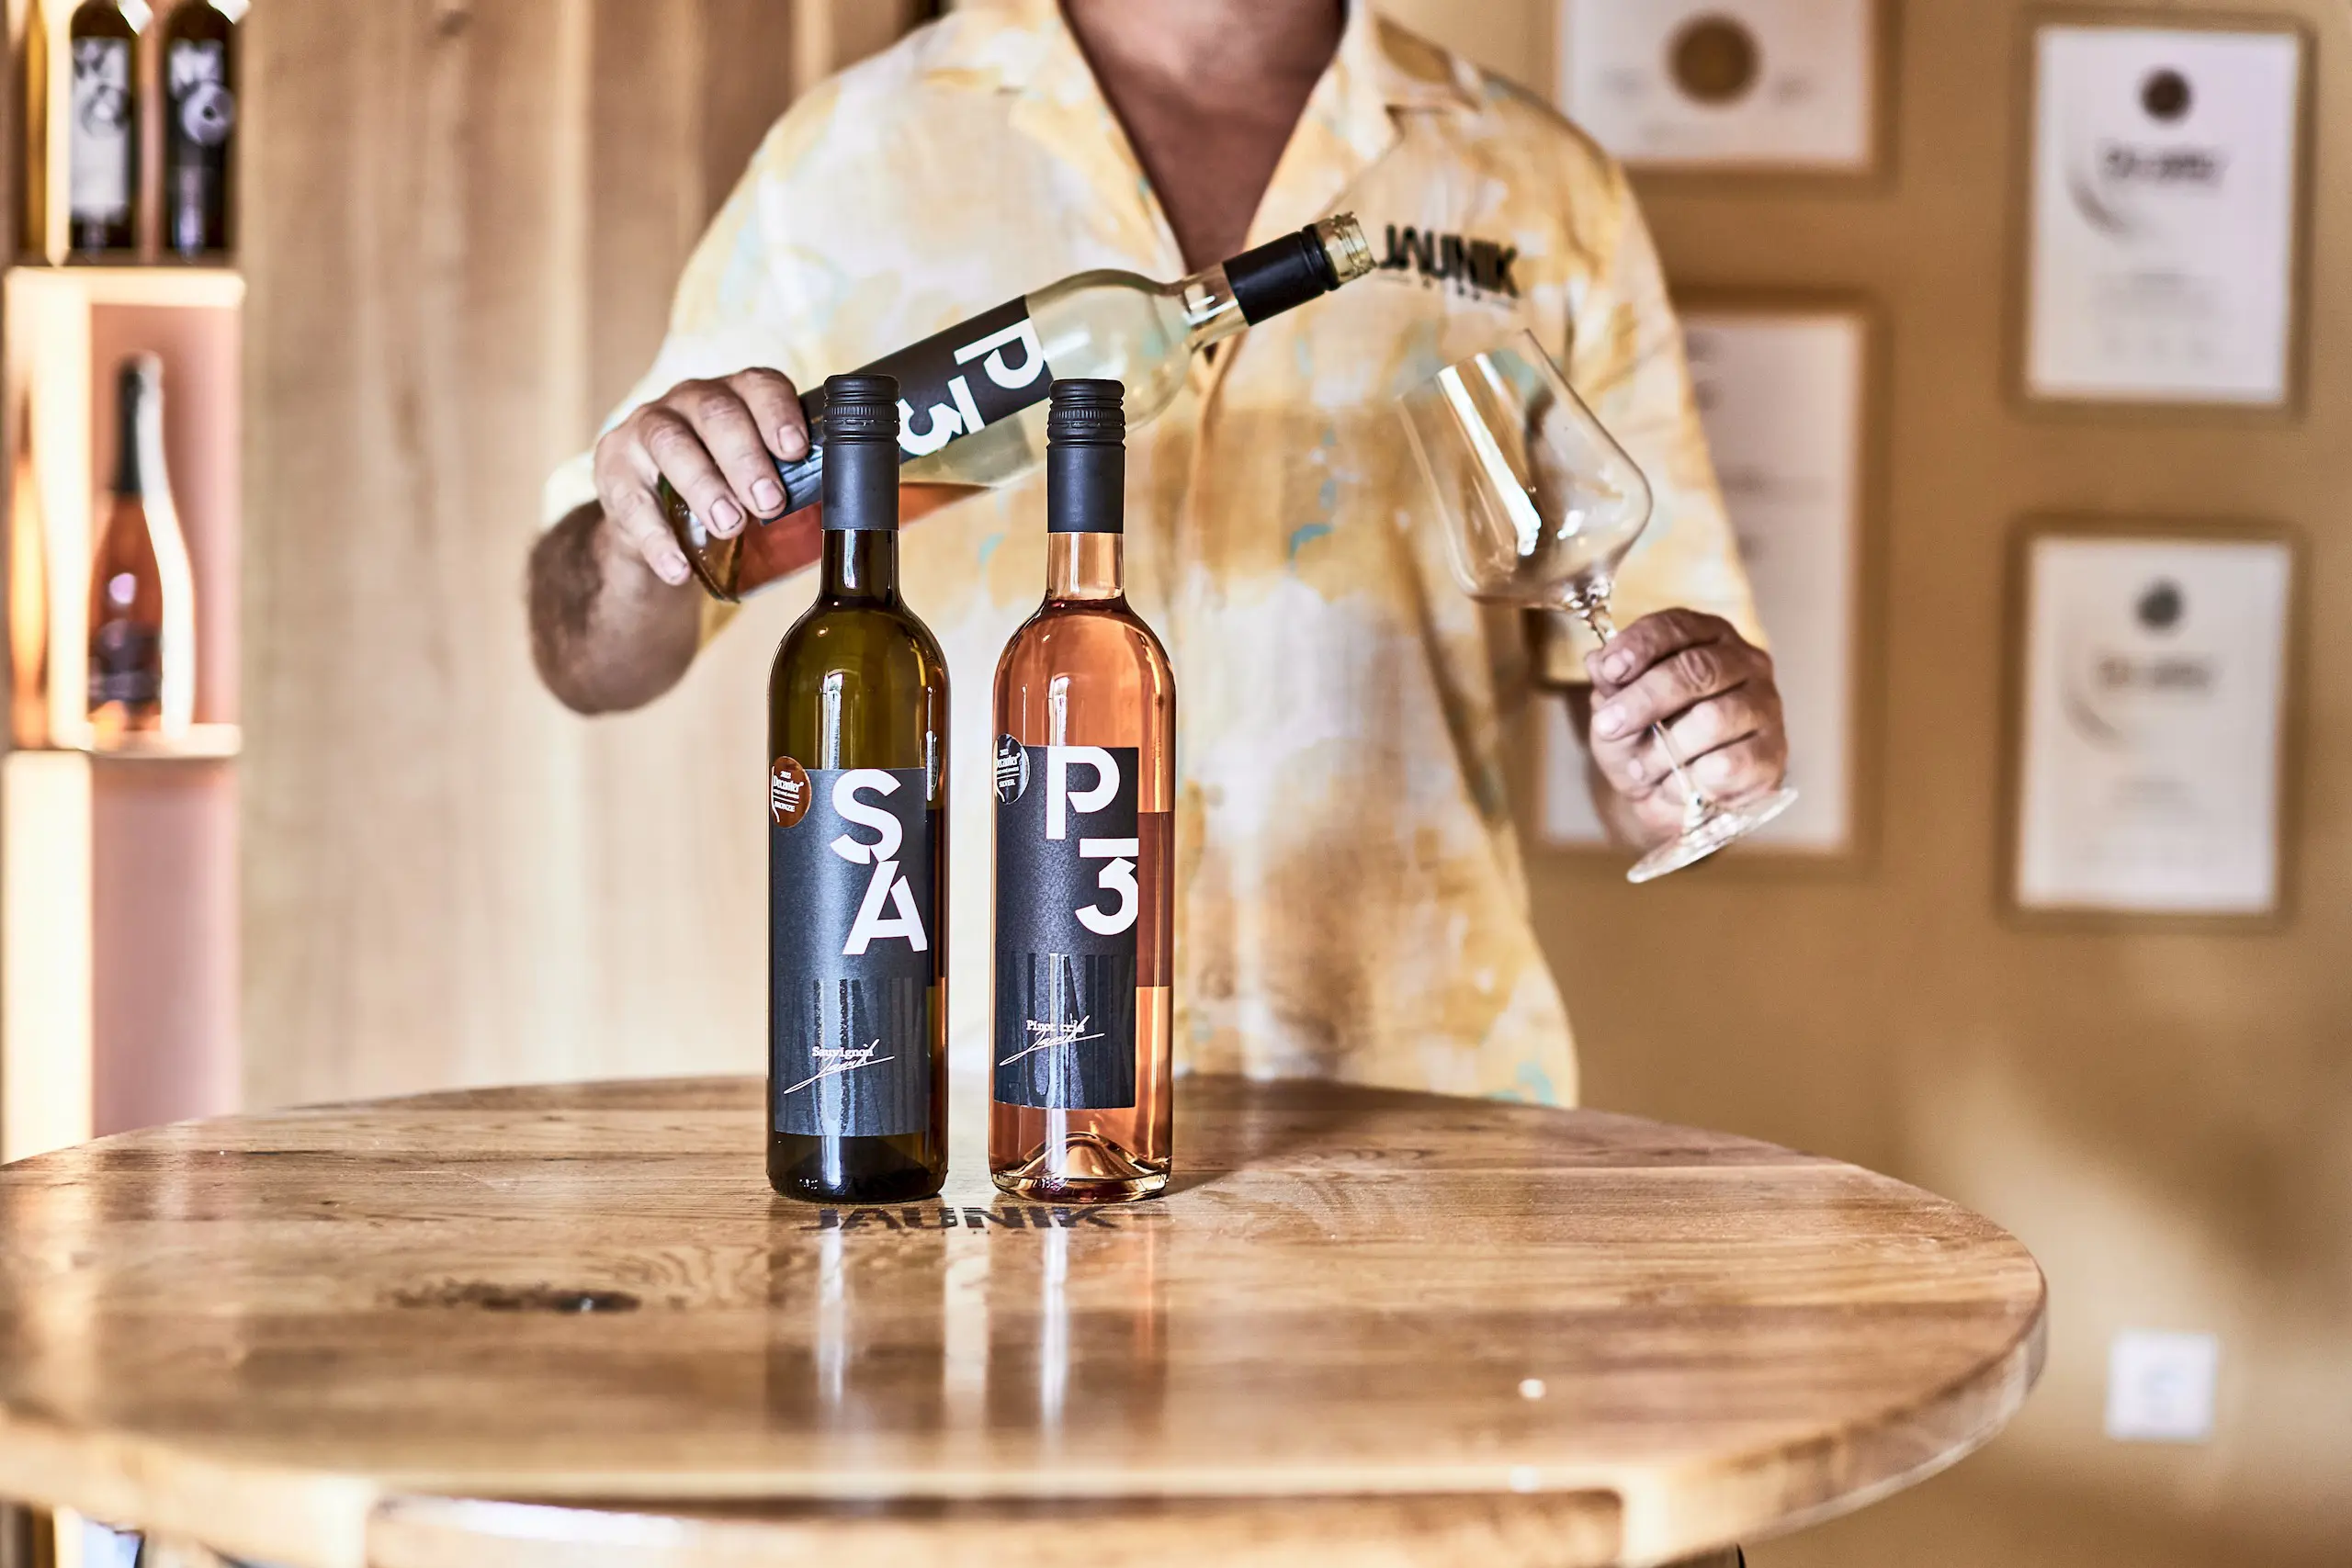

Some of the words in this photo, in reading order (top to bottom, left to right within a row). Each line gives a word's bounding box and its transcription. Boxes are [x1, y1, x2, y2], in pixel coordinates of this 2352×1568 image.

[954, 317, 1044, 389] P
[996, 752, 1021, 768] ecanter
[831, 769, 903, 864] S
[1046, 745, 1120, 840] P
[842, 861, 928, 955] A
[1026, 1020, 1057, 1032] Pinot
[811, 1045, 875, 1060] Sauvignon
[798, 1206, 1120, 1230] JAUNIK
